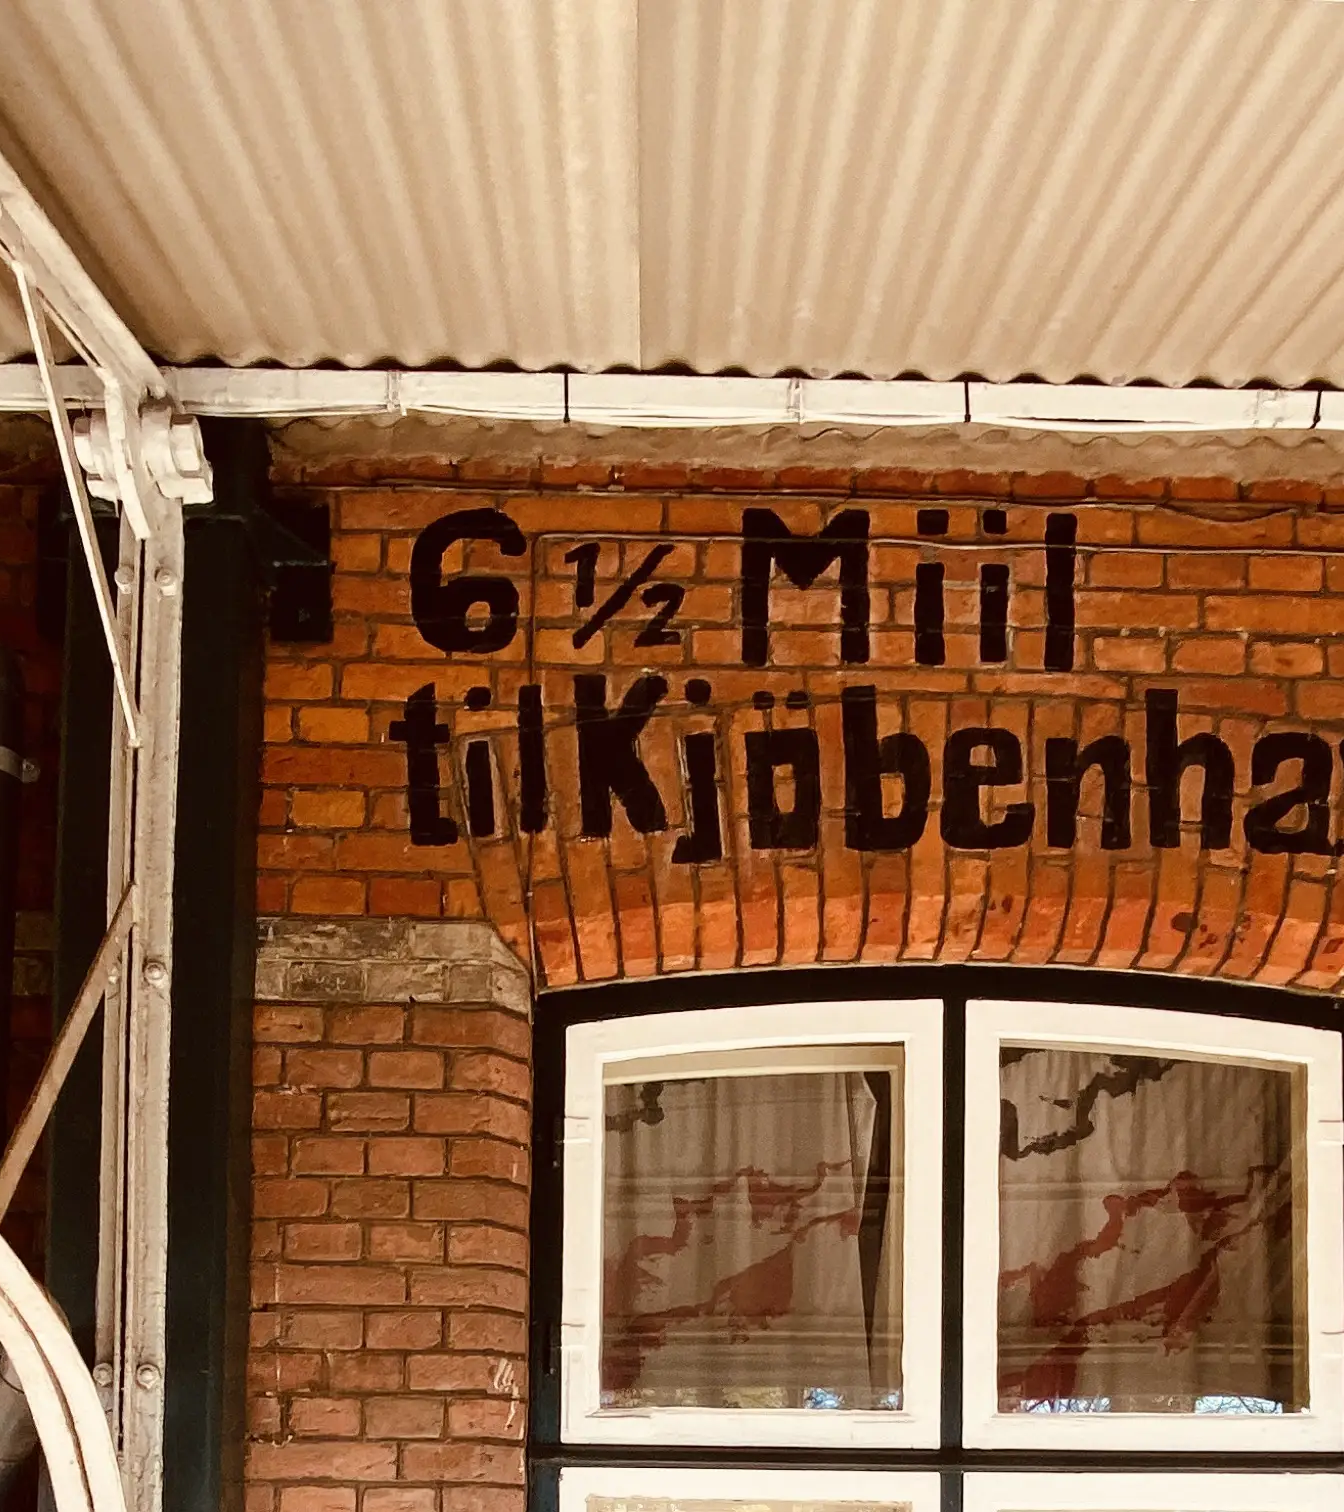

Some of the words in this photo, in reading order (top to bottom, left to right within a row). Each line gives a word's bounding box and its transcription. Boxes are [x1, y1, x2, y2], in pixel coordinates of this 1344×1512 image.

[410, 507, 527, 654] 6
[741, 507, 1078, 672] Miil
[388, 682, 549, 846] til
